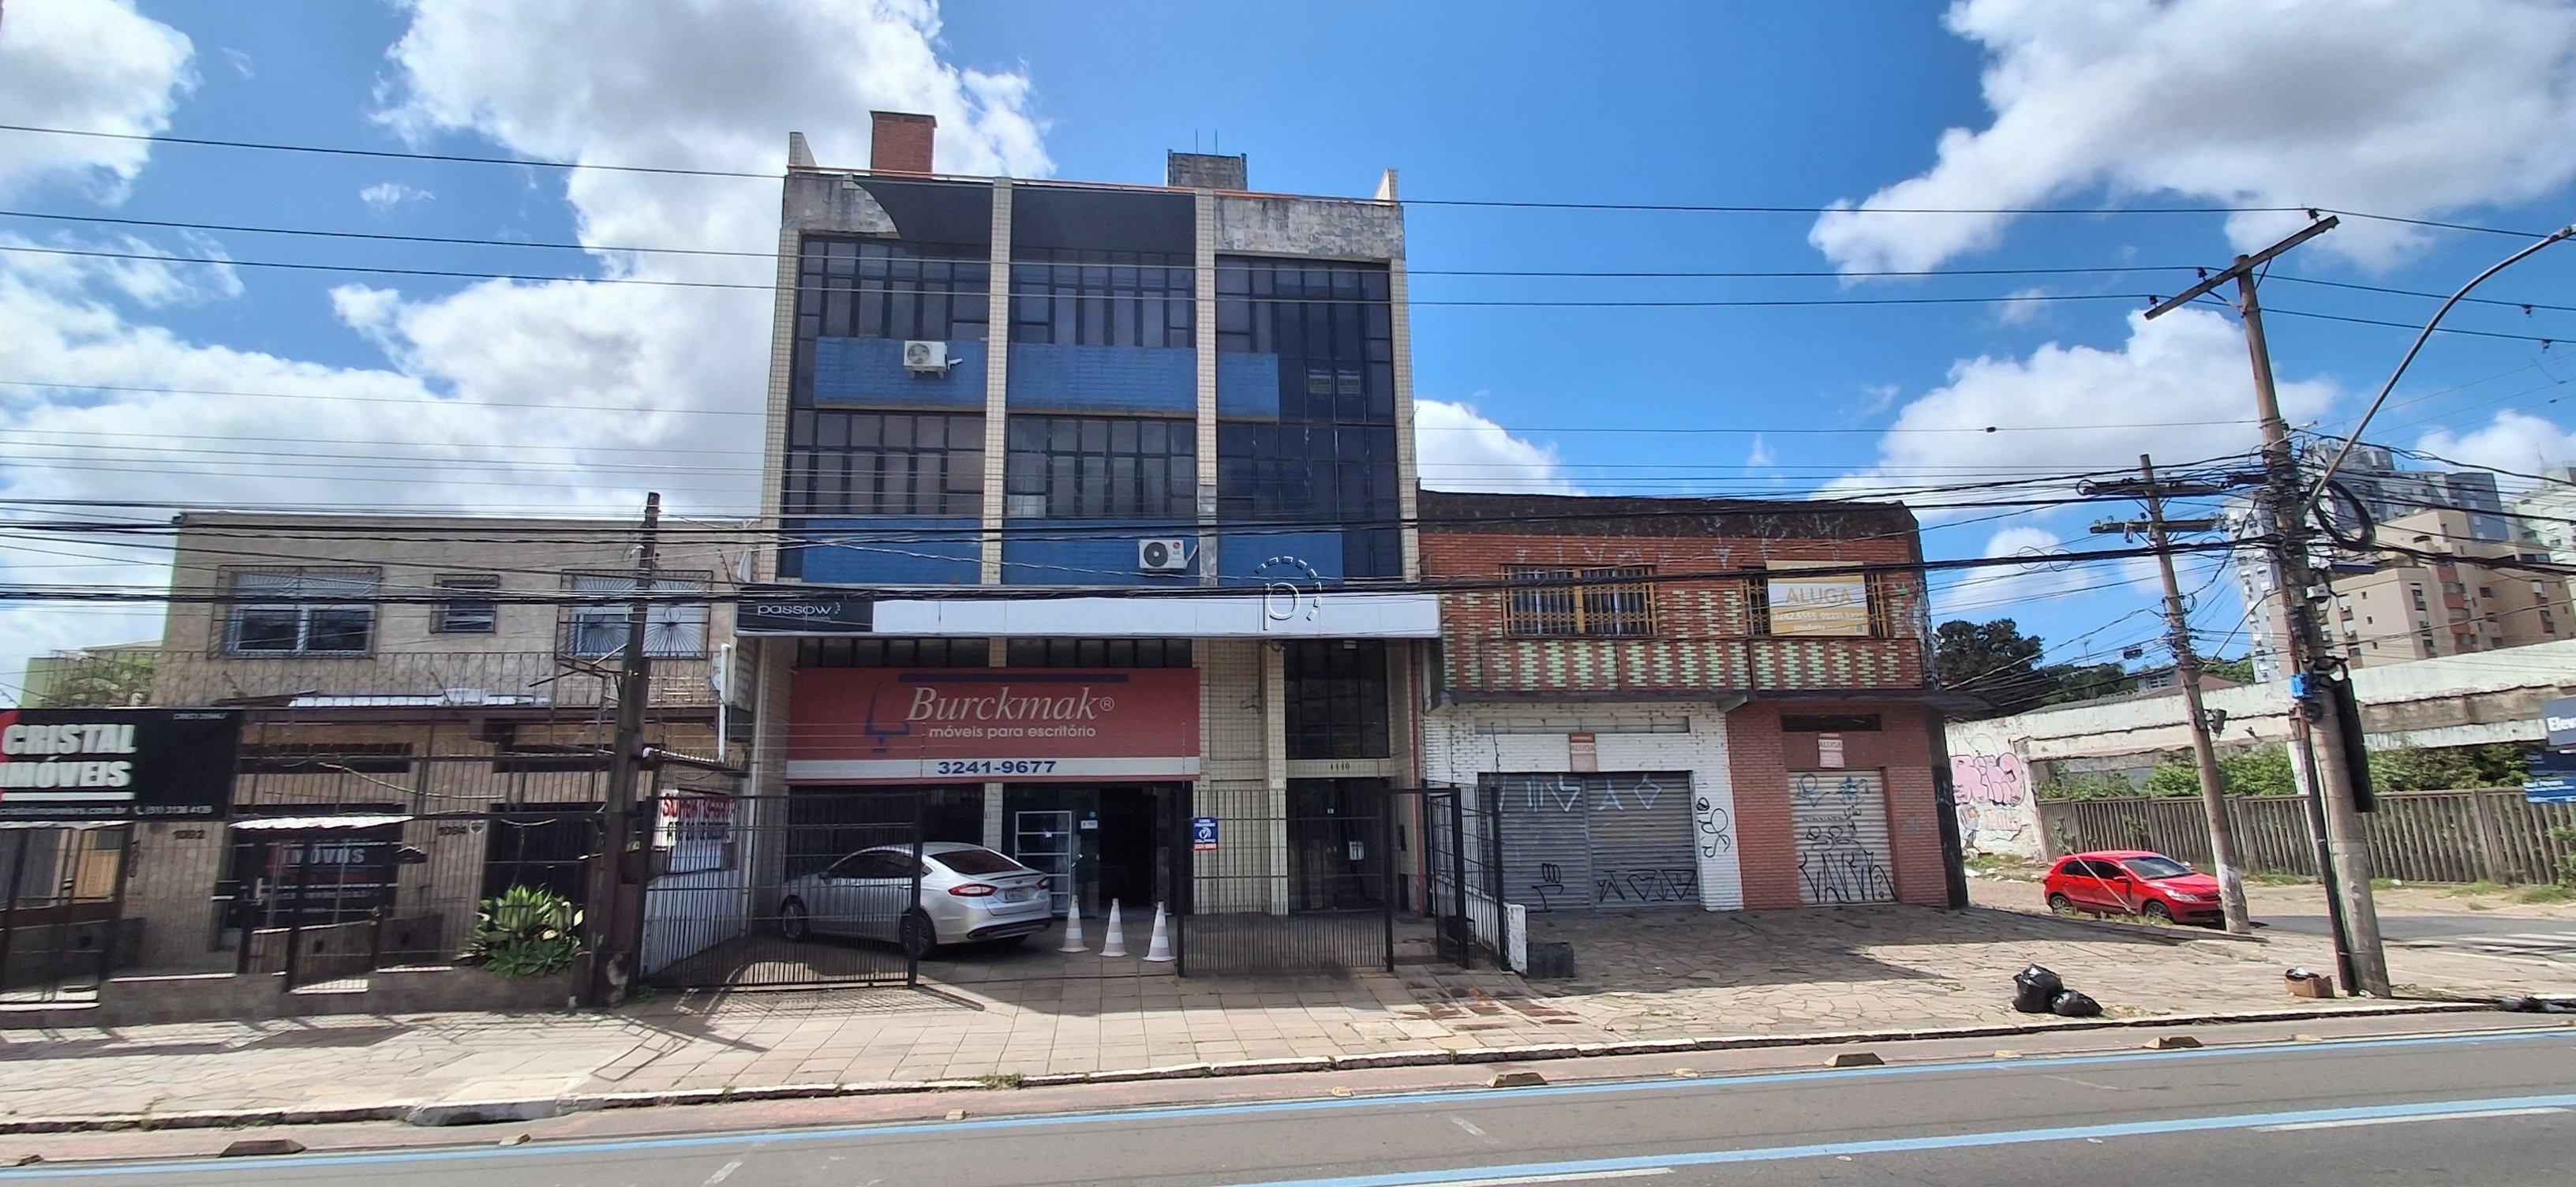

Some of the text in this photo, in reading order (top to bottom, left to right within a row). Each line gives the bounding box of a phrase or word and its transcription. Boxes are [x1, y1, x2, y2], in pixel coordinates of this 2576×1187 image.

[1785, 587, 1852, 603] ALUGA
[758, 605, 833, 616] passow
[2, 724, 137, 755] CRISTAL
[929, 725, 1096, 740] móveis para escritório
[0, 755, 133, 788] IMÓVEIS
[938, 760, 1058, 775] 3241-9677
